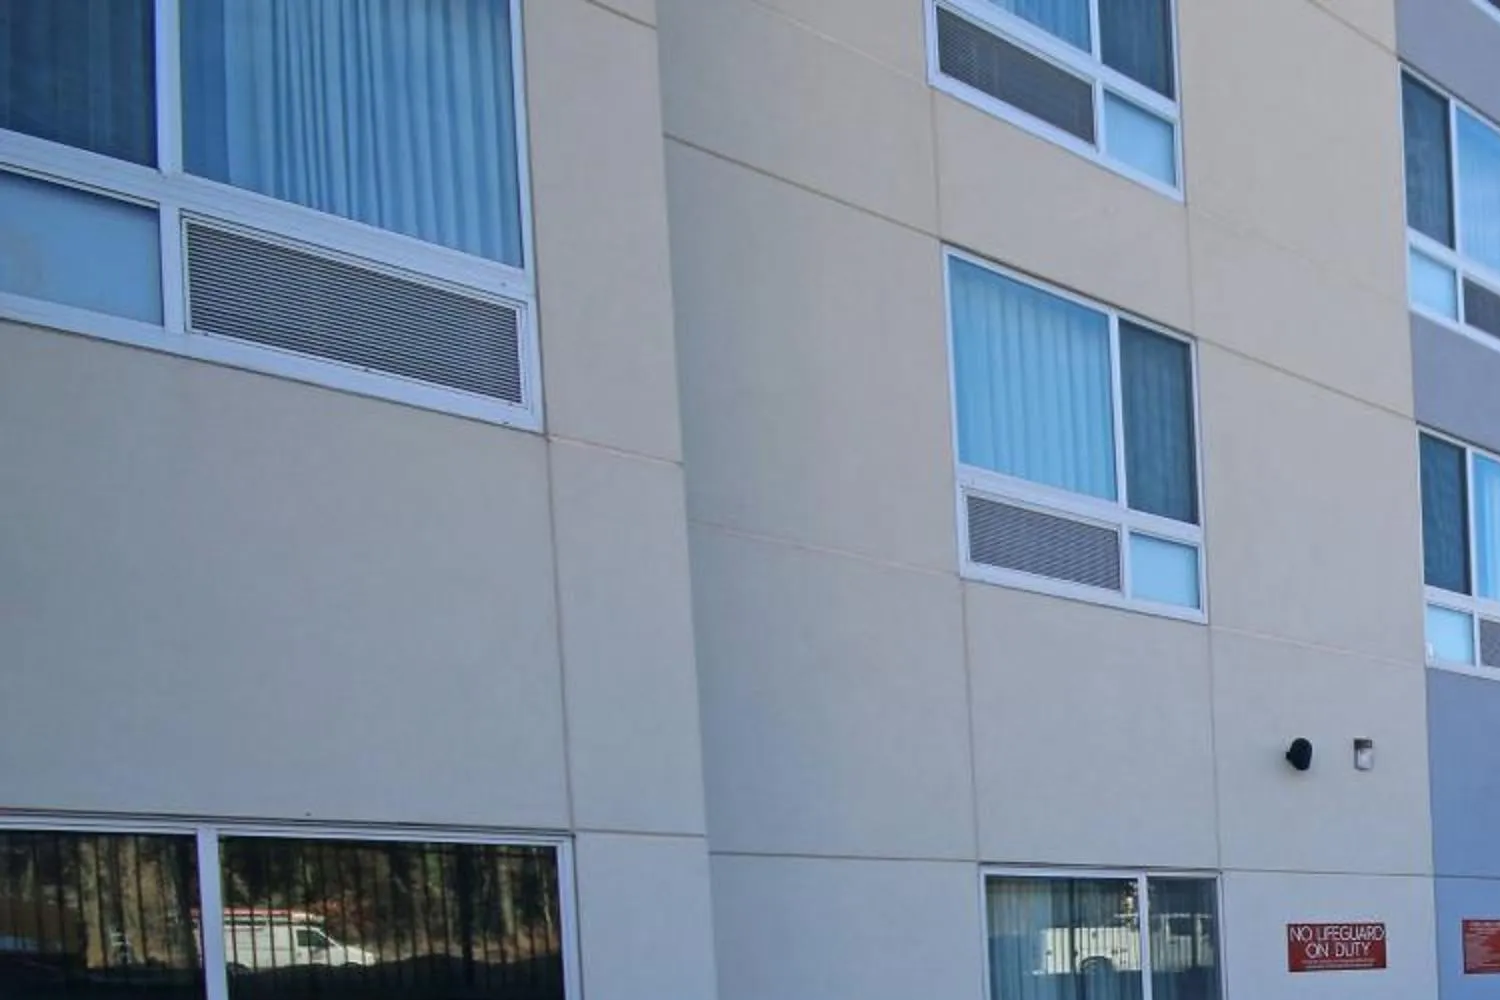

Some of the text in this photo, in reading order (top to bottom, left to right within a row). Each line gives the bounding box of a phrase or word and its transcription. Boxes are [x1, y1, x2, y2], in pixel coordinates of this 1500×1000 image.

[1289, 925, 1385, 941] NO LIFEGUARD
[1305, 942, 1372, 958] ON DUTY
